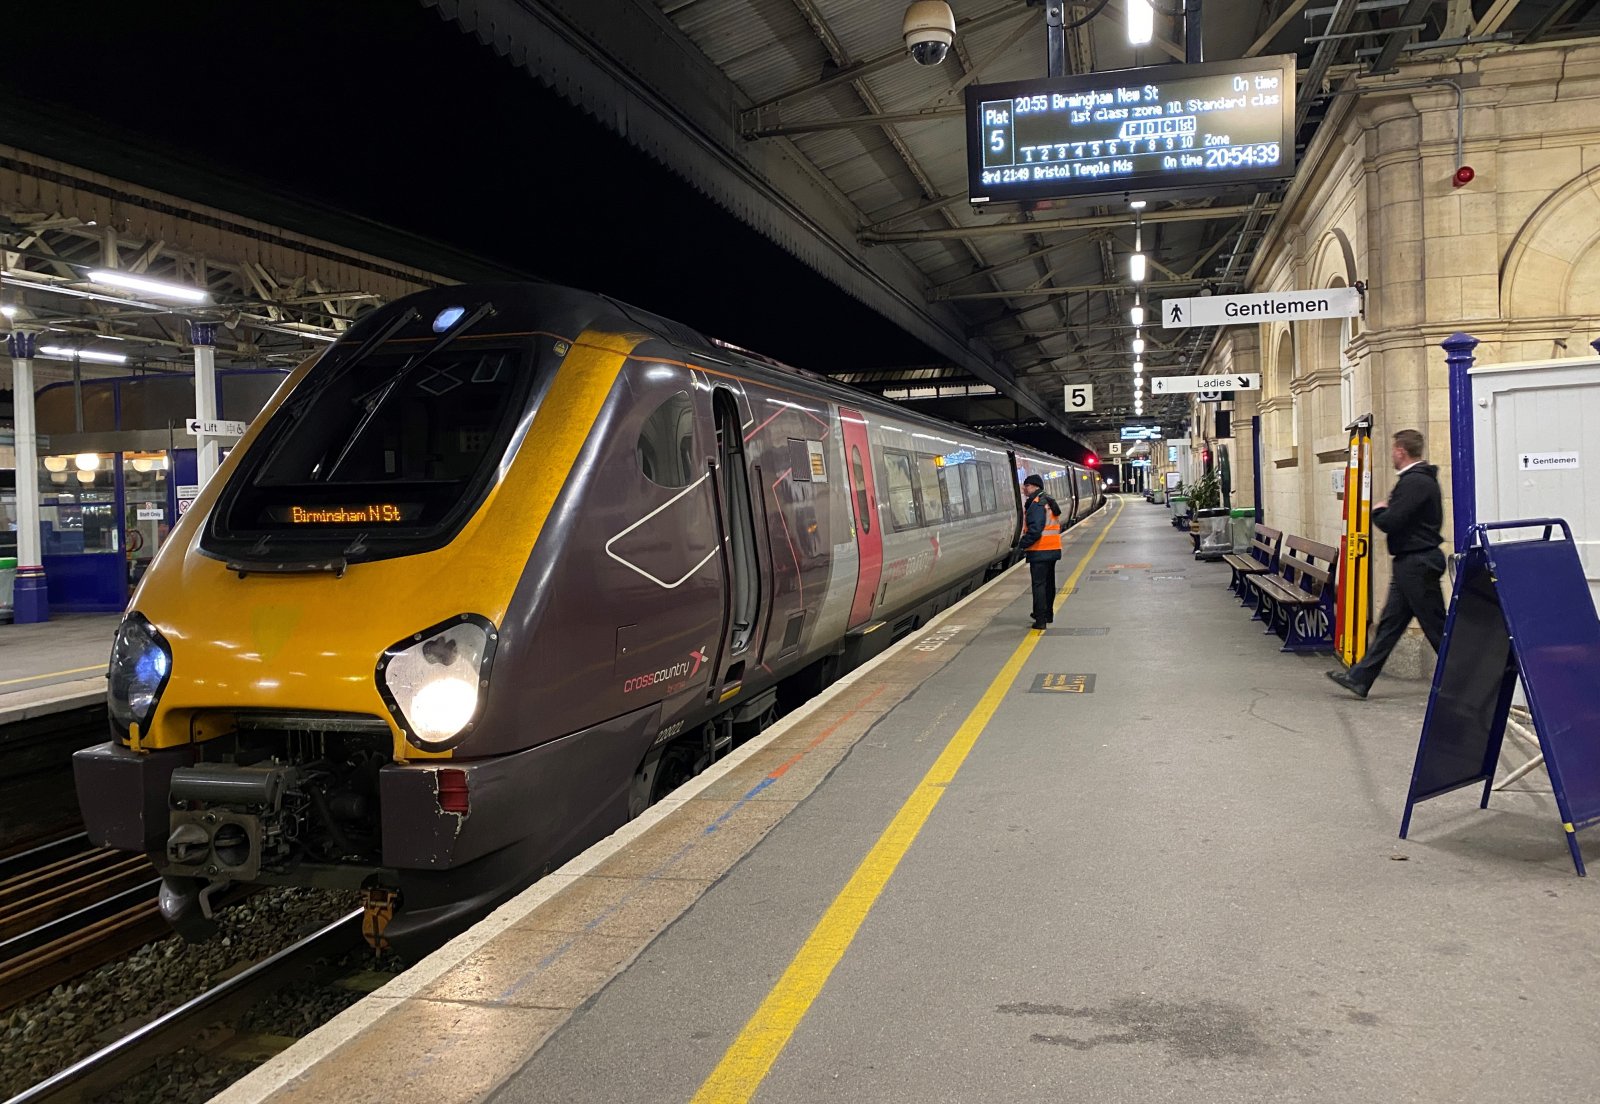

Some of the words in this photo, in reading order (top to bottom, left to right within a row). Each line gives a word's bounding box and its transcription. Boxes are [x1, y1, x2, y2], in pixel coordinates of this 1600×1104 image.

[1233, 76, 1249, 91] On
[1255, 75, 1278, 90] time
[1016, 94, 1048, 112] 20:55
[1053, 89, 1113, 109] Birmingham
[1118, 87, 1140, 102] New
[1144, 85, 1159, 100] St
[1071, 110, 1091, 123] 1st
[1094, 108, 1128, 121] class
[1132, 104, 1162, 117] zone
[1188, 95, 1246, 112] Standard
[1251, 93, 1279, 106] clas
[986, 110, 1009, 125] Plat
[1128, 123, 1137, 136] F
[1146, 122, 1155, 134] D
[1164, 121, 1172, 132] C
[1180, 119, 1192, 131] 1st
[990, 129, 1005, 151] 5
[1025, 150, 1032, 162] 1
[1041, 149, 1049, 161] 2
[1058, 147, 1066, 159] 3
[1075, 146, 1083, 157] 4
[1092, 144, 1100, 156] 5
[1109, 143, 1117, 154] 6
[1129, 140, 1136, 152] 7
[1149, 139, 1156, 151] 8
[1166, 138, 1173, 149] 9
[1181, 136, 1193, 148] 10
[1205, 133, 1230, 146] Zone
[1206, 144, 1280, 168] 20:54:39
[982, 168, 1001, 184] 3rd
[1034, 164, 1070, 179] Bristol
[1074, 161, 1110, 177] Temple
[1113, 159, 1133, 172] Mds
[1164, 156, 1177, 169] On
[1180, 154, 1202, 167] time
[1225, 299, 1329, 317] Gentlemen
[1196, 378, 1232, 388] Ladies
[1071, 388, 1086, 407] 5
[204, 423, 218, 432] Lift
[1112, 444, 1119, 452] 5
[1532, 456, 1576, 465] Gentlemen
[292, 506, 366, 522] Birmingham
[369, 505, 379, 521] N
[383, 505, 400, 521] St
[1294, 608, 1329, 638] GWR
[623, 661, 690, 693] crosscountry
